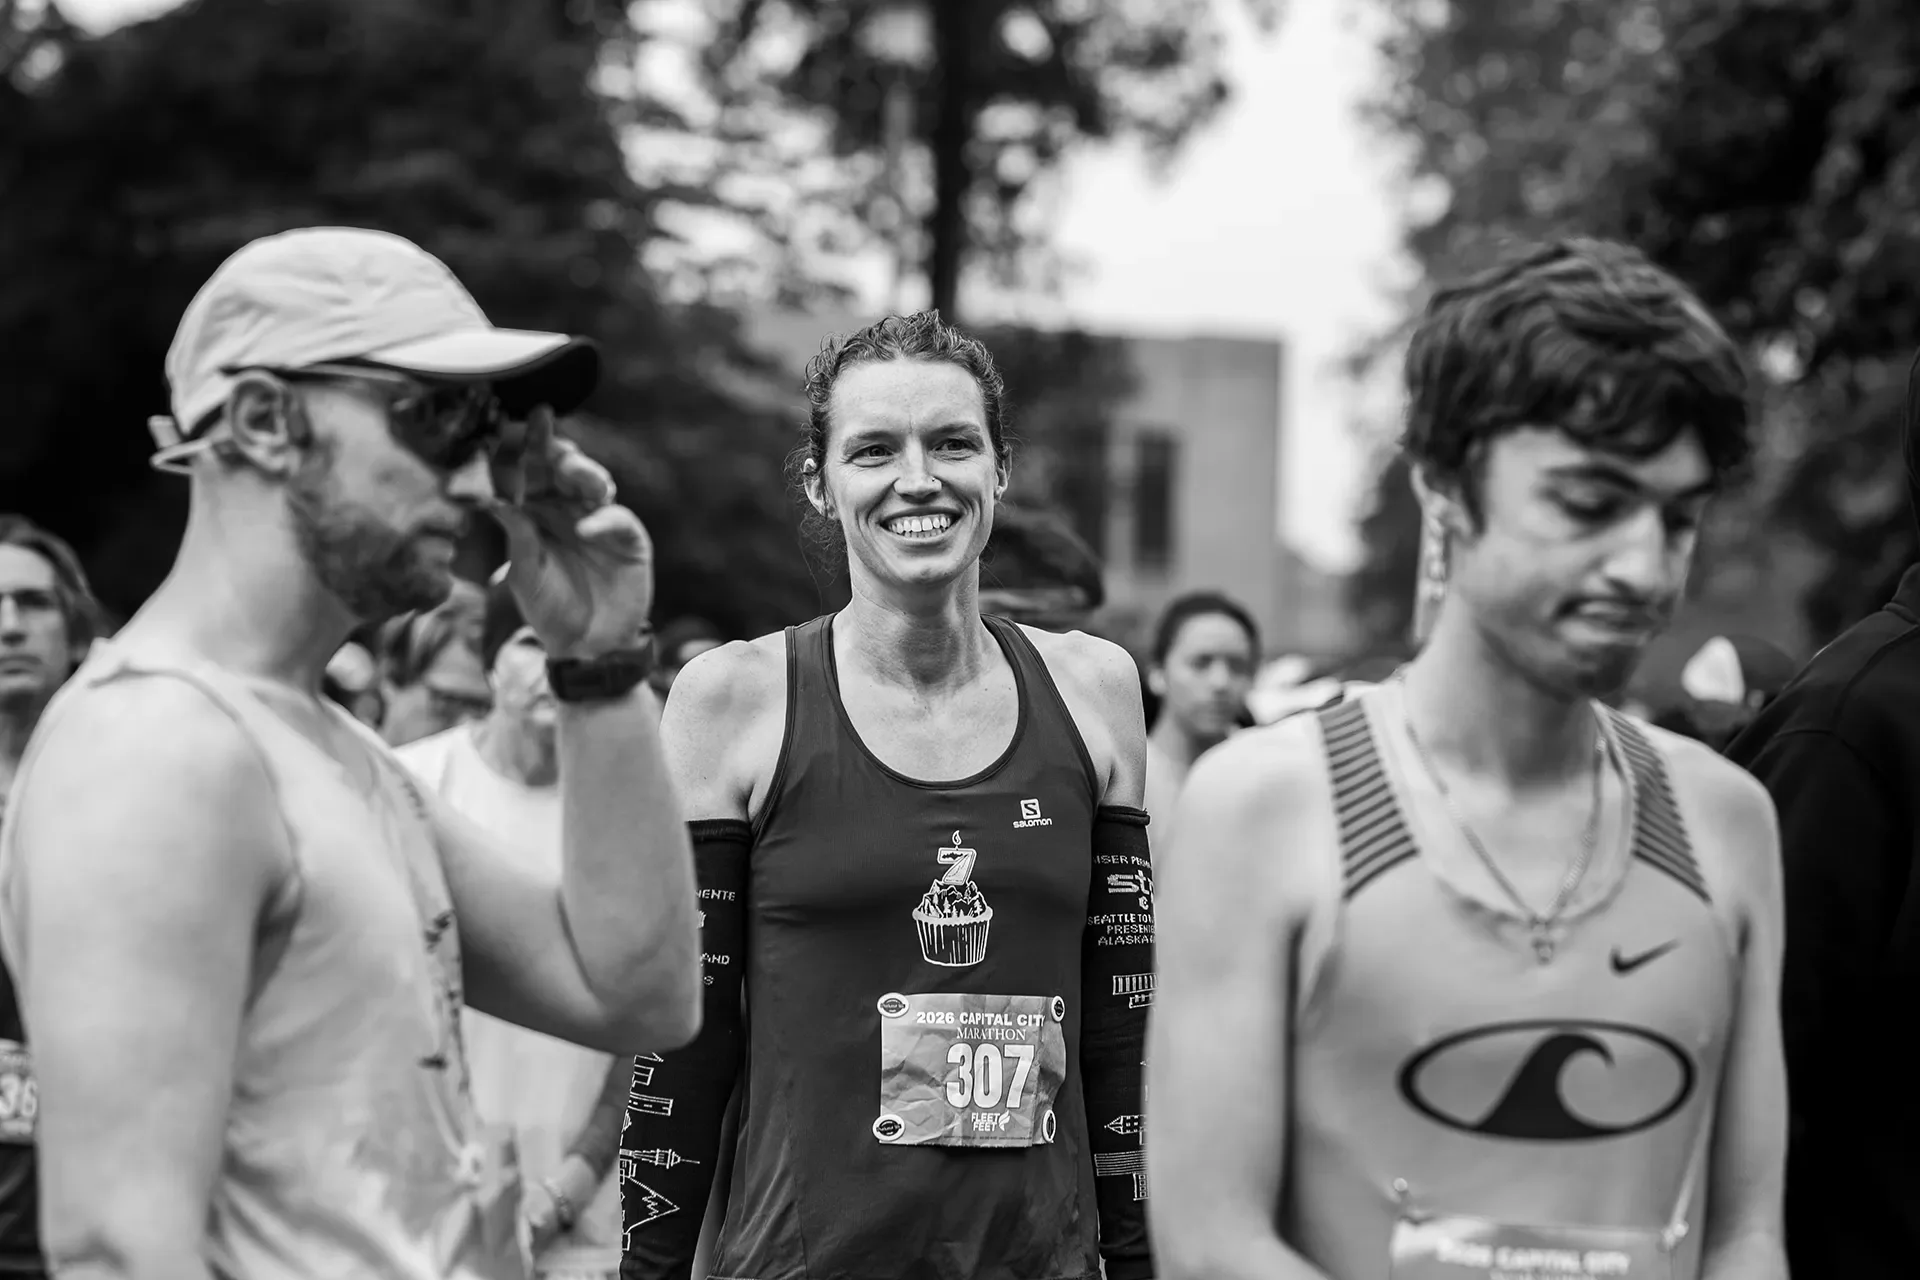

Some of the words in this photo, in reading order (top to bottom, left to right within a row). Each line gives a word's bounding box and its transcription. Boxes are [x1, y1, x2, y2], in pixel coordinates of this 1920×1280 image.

[1012, 818, 1052, 829] salomon
[1094, 855, 1129, 864] ISER
[1087, 912, 1136, 925] SEATTLE
[916, 1011, 955, 1024] 2026
[959, 1012, 1013, 1026] CAPITAL
[956, 1027, 1027, 1041] MARATHON
[945, 1042, 1035, 1109] 307
[971, 1112, 1000, 1123] FLEET
[972, 1122, 998, 1132] FEET
